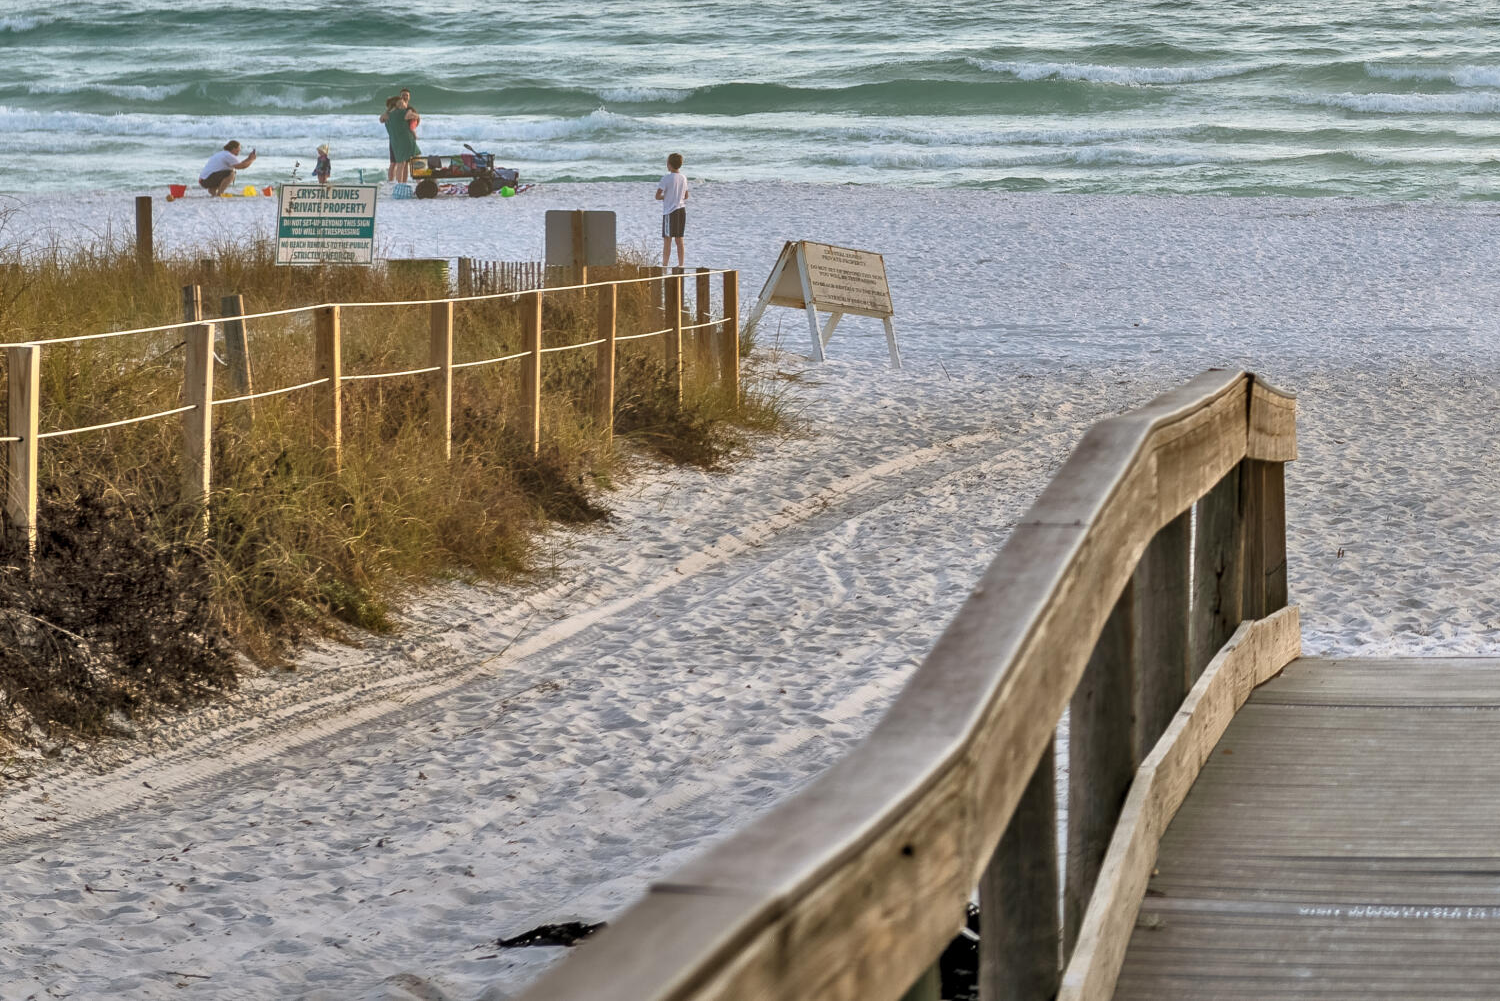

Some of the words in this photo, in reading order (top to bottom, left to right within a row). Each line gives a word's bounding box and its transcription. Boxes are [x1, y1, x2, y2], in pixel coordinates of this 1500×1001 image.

[297, 188, 330, 199] CRYSTAL
[332, 189, 360, 200] DUNES
[323, 203, 366, 214] PROPERTY
